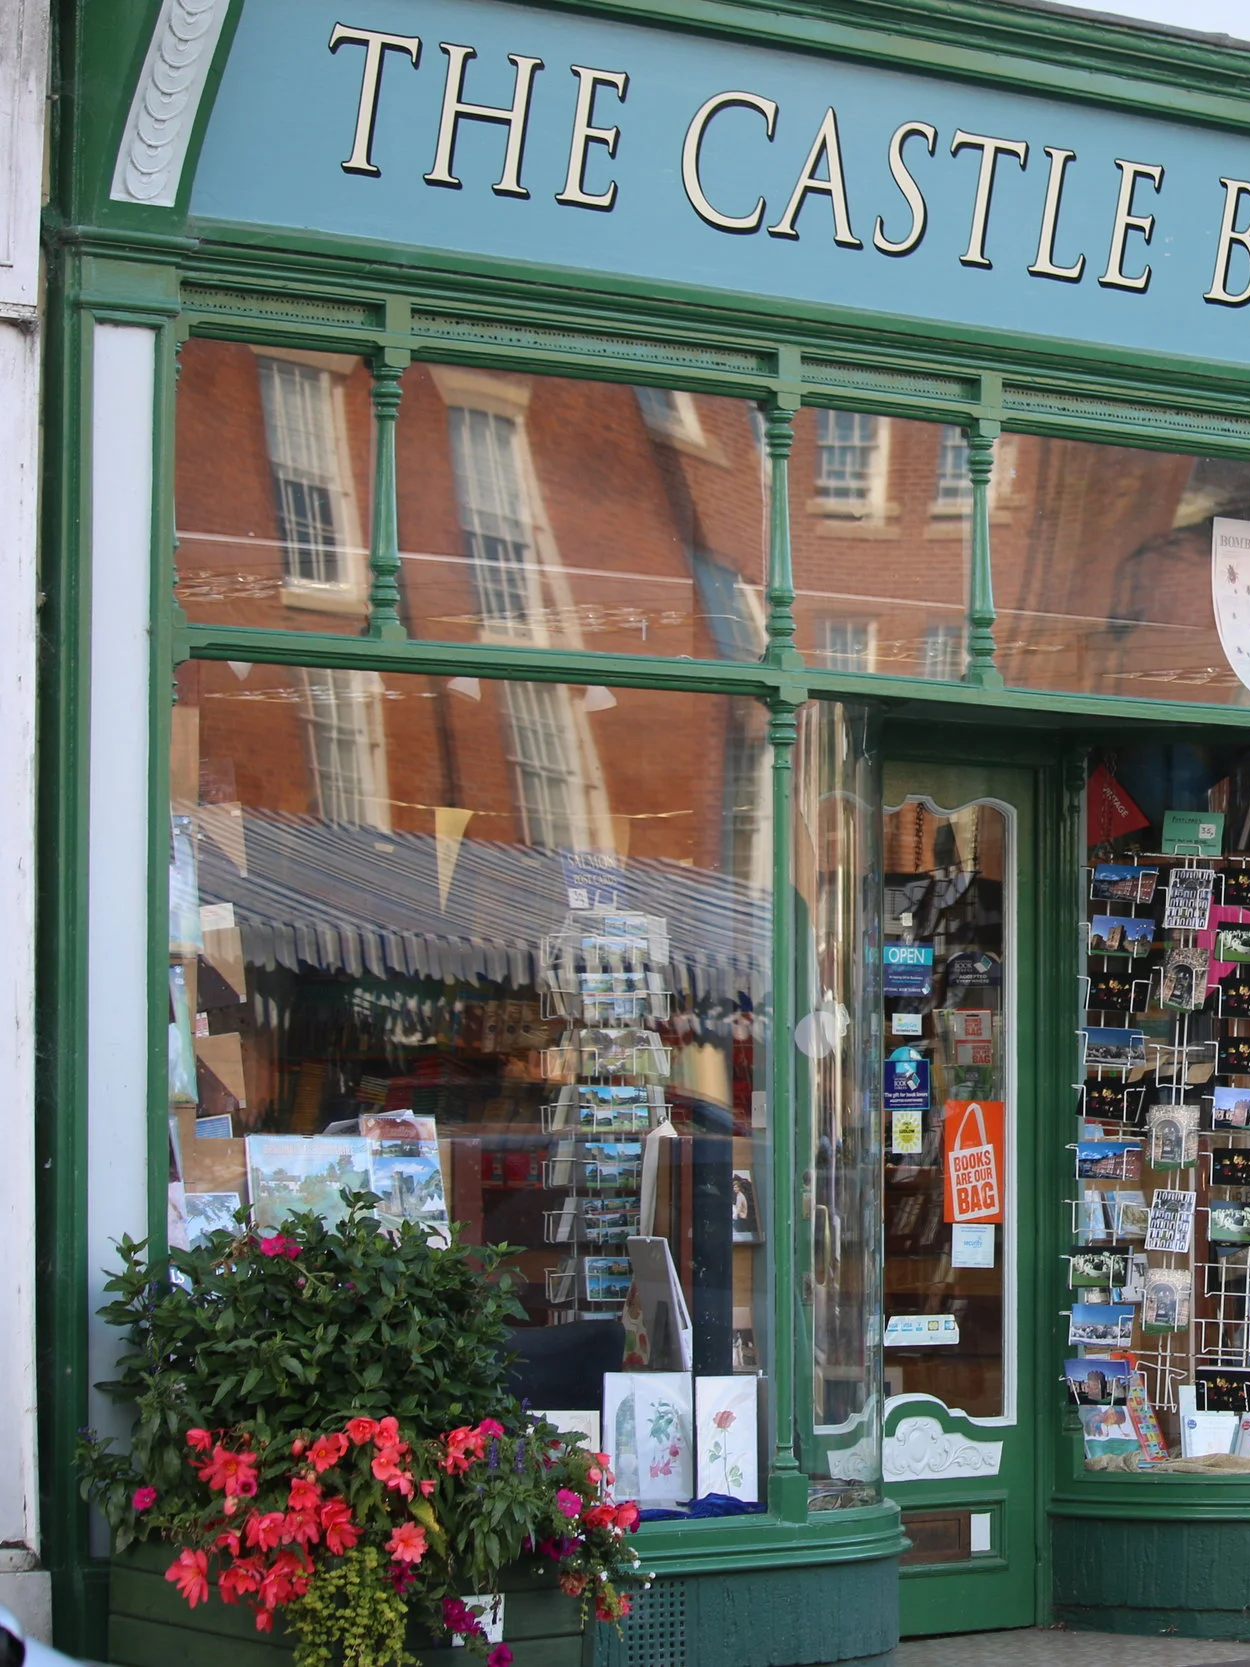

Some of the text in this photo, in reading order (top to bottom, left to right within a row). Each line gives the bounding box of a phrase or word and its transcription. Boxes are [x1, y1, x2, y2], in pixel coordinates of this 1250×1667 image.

[328, 21, 630, 211] THE
[681, 90, 1165, 294] CASTLE
[888, 947, 925, 964] OPEN
[953, 1150, 991, 1173] BOOKS
[955, 1166, 993, 1187] ARE OUR
[956, 1182, 996, 1215] BAG
